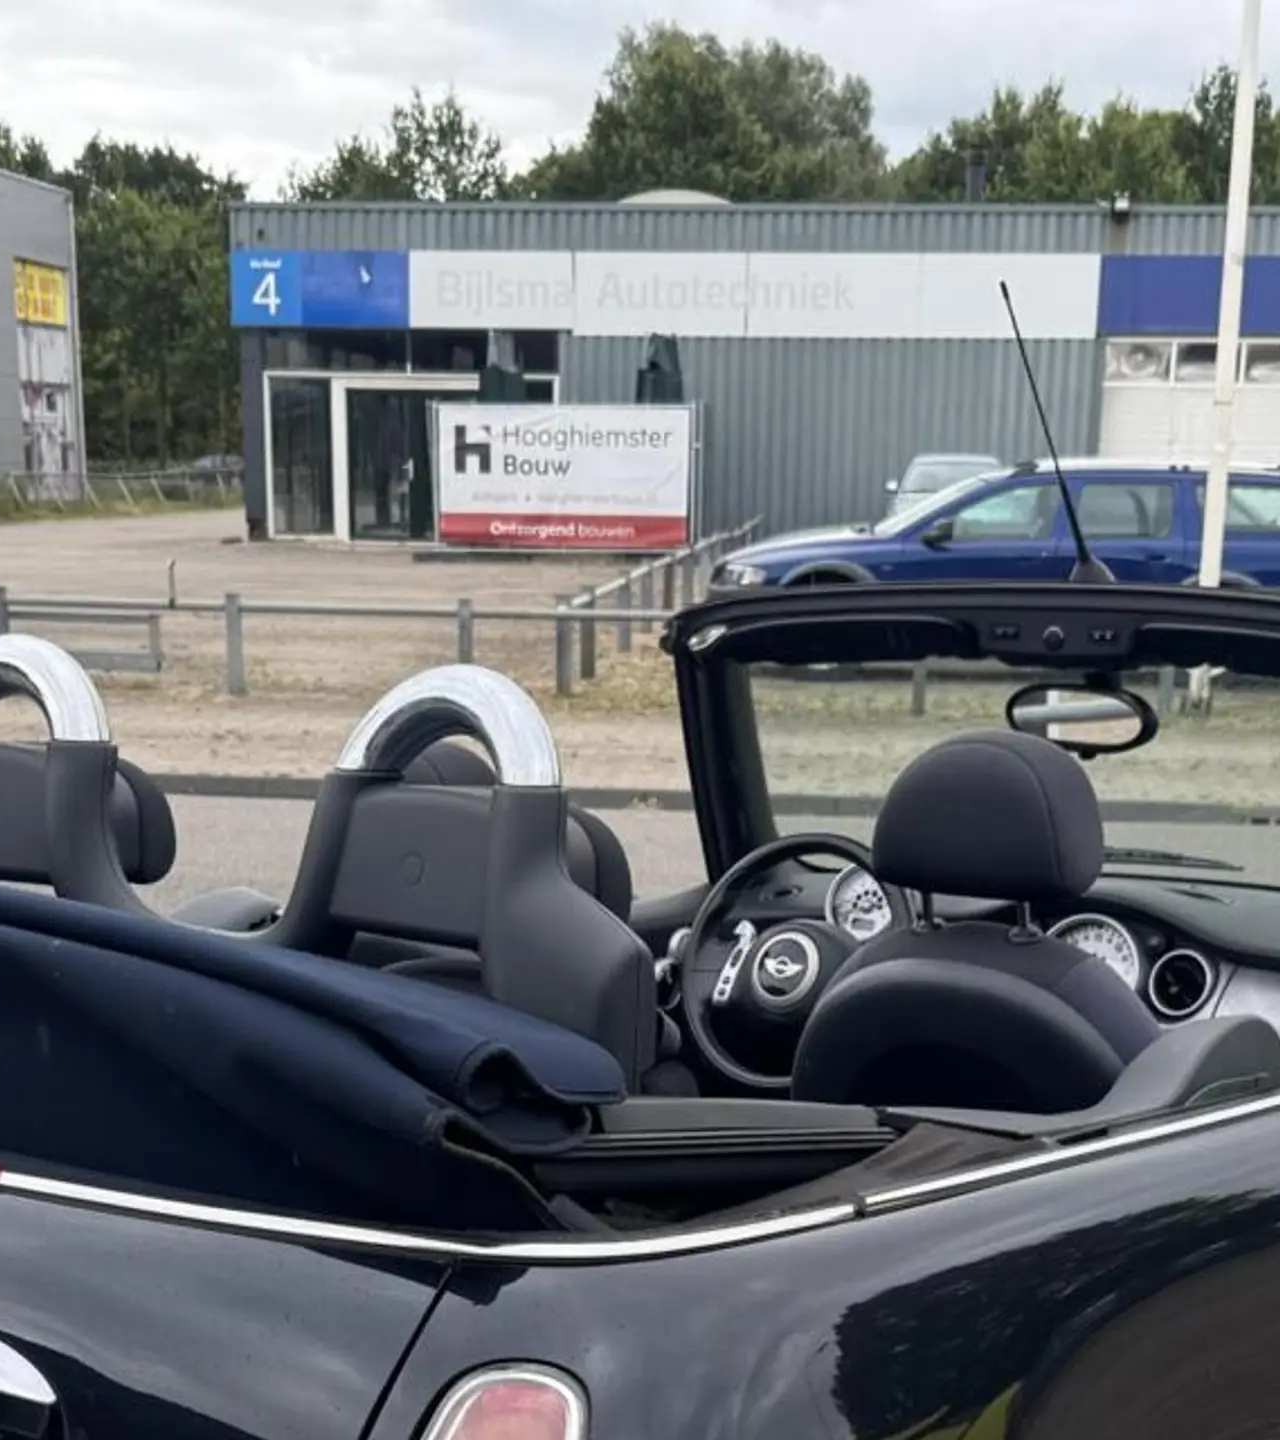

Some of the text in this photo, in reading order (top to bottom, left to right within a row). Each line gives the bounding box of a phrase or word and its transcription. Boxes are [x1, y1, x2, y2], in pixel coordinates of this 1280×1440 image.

[252, 271, 282, 317] 4
[436, 270, 856, 315] Bijlsma Autotechniek
[503, 454, 572, 476] Bouw
